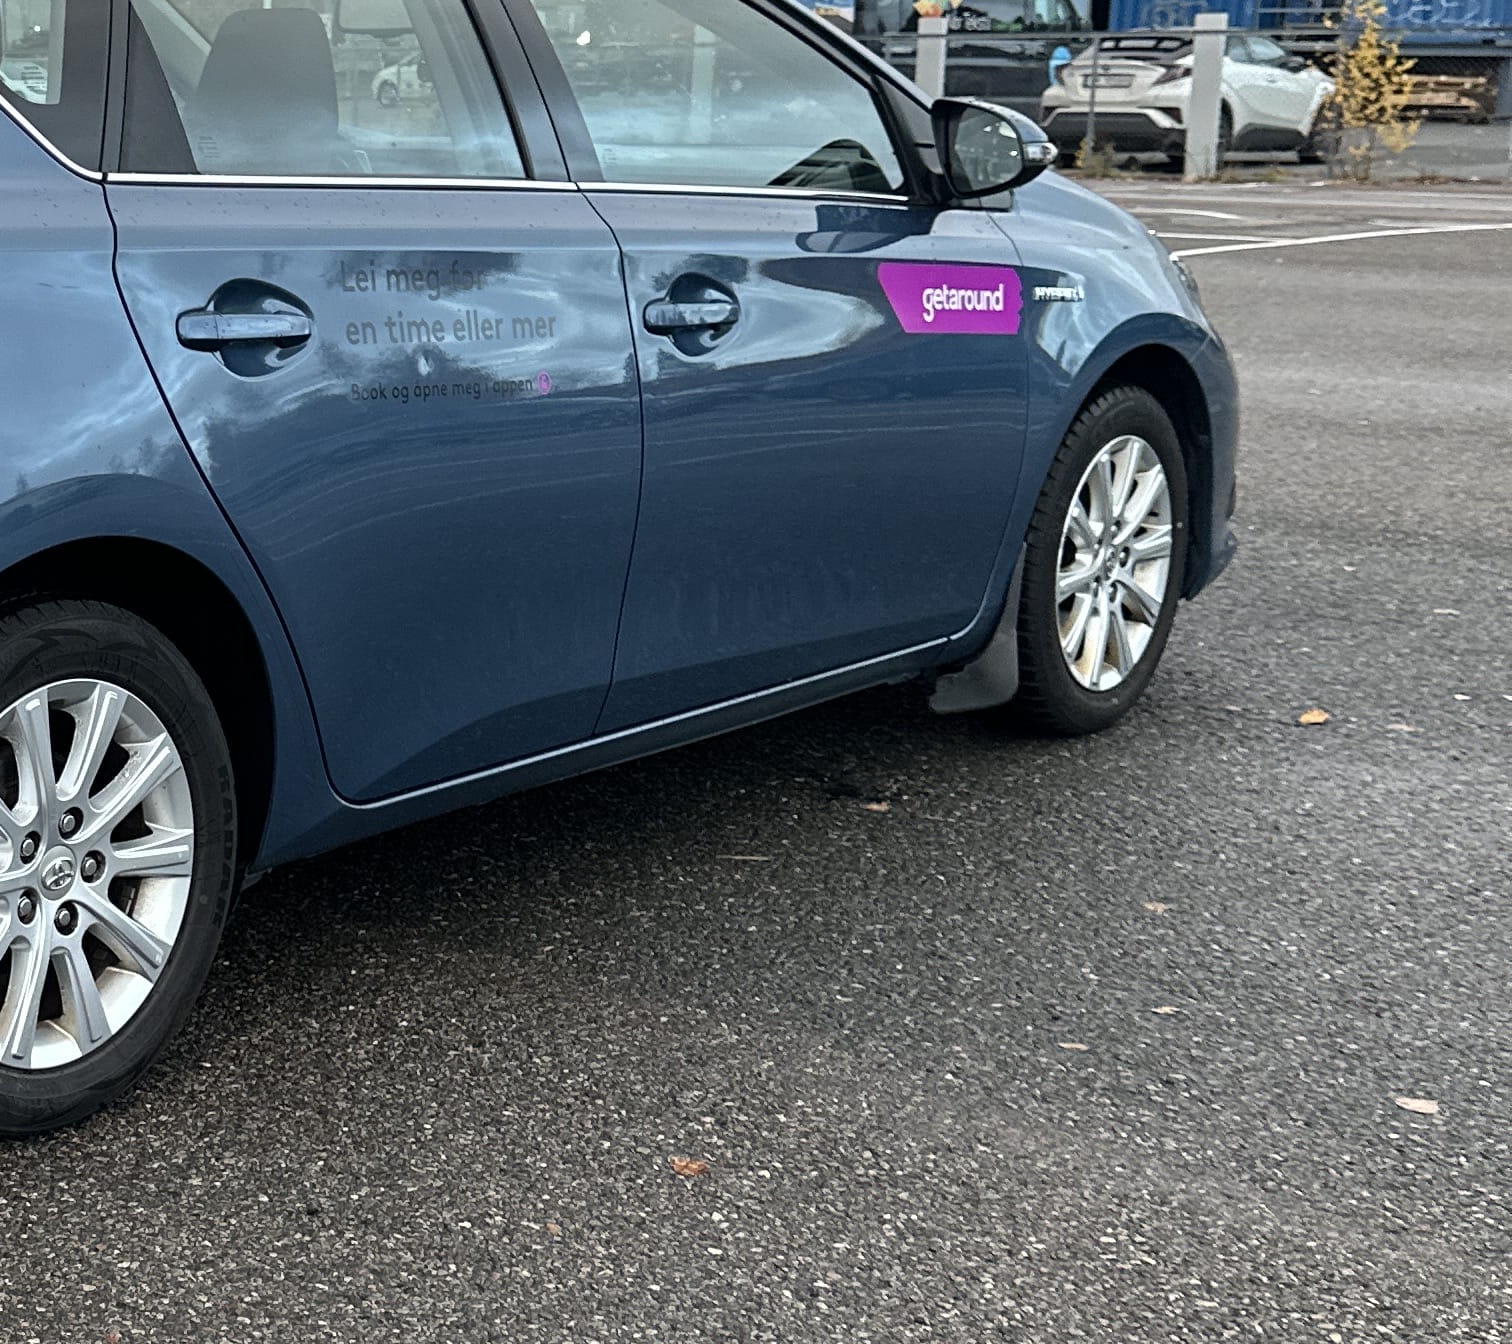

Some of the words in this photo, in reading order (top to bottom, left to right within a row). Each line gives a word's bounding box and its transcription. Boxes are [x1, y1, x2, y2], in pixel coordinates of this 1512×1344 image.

[340, 259, 377, 292] Lei
[387, 267, 441, 301] meg
[449, 260, 488, 290] for
[922, 284, 1004, 322] getaround
[345, 321, 378, 345] en
[384, 310, 445, 343] time
[453, 309, 503, 341] eller
[511, 315, 557, 338] mer
[351, 383, 388, 400] Book
[391, 384, 409, 404] og
[452, 382, 482, 399] meg
[492, 378, 533, 398] appen
